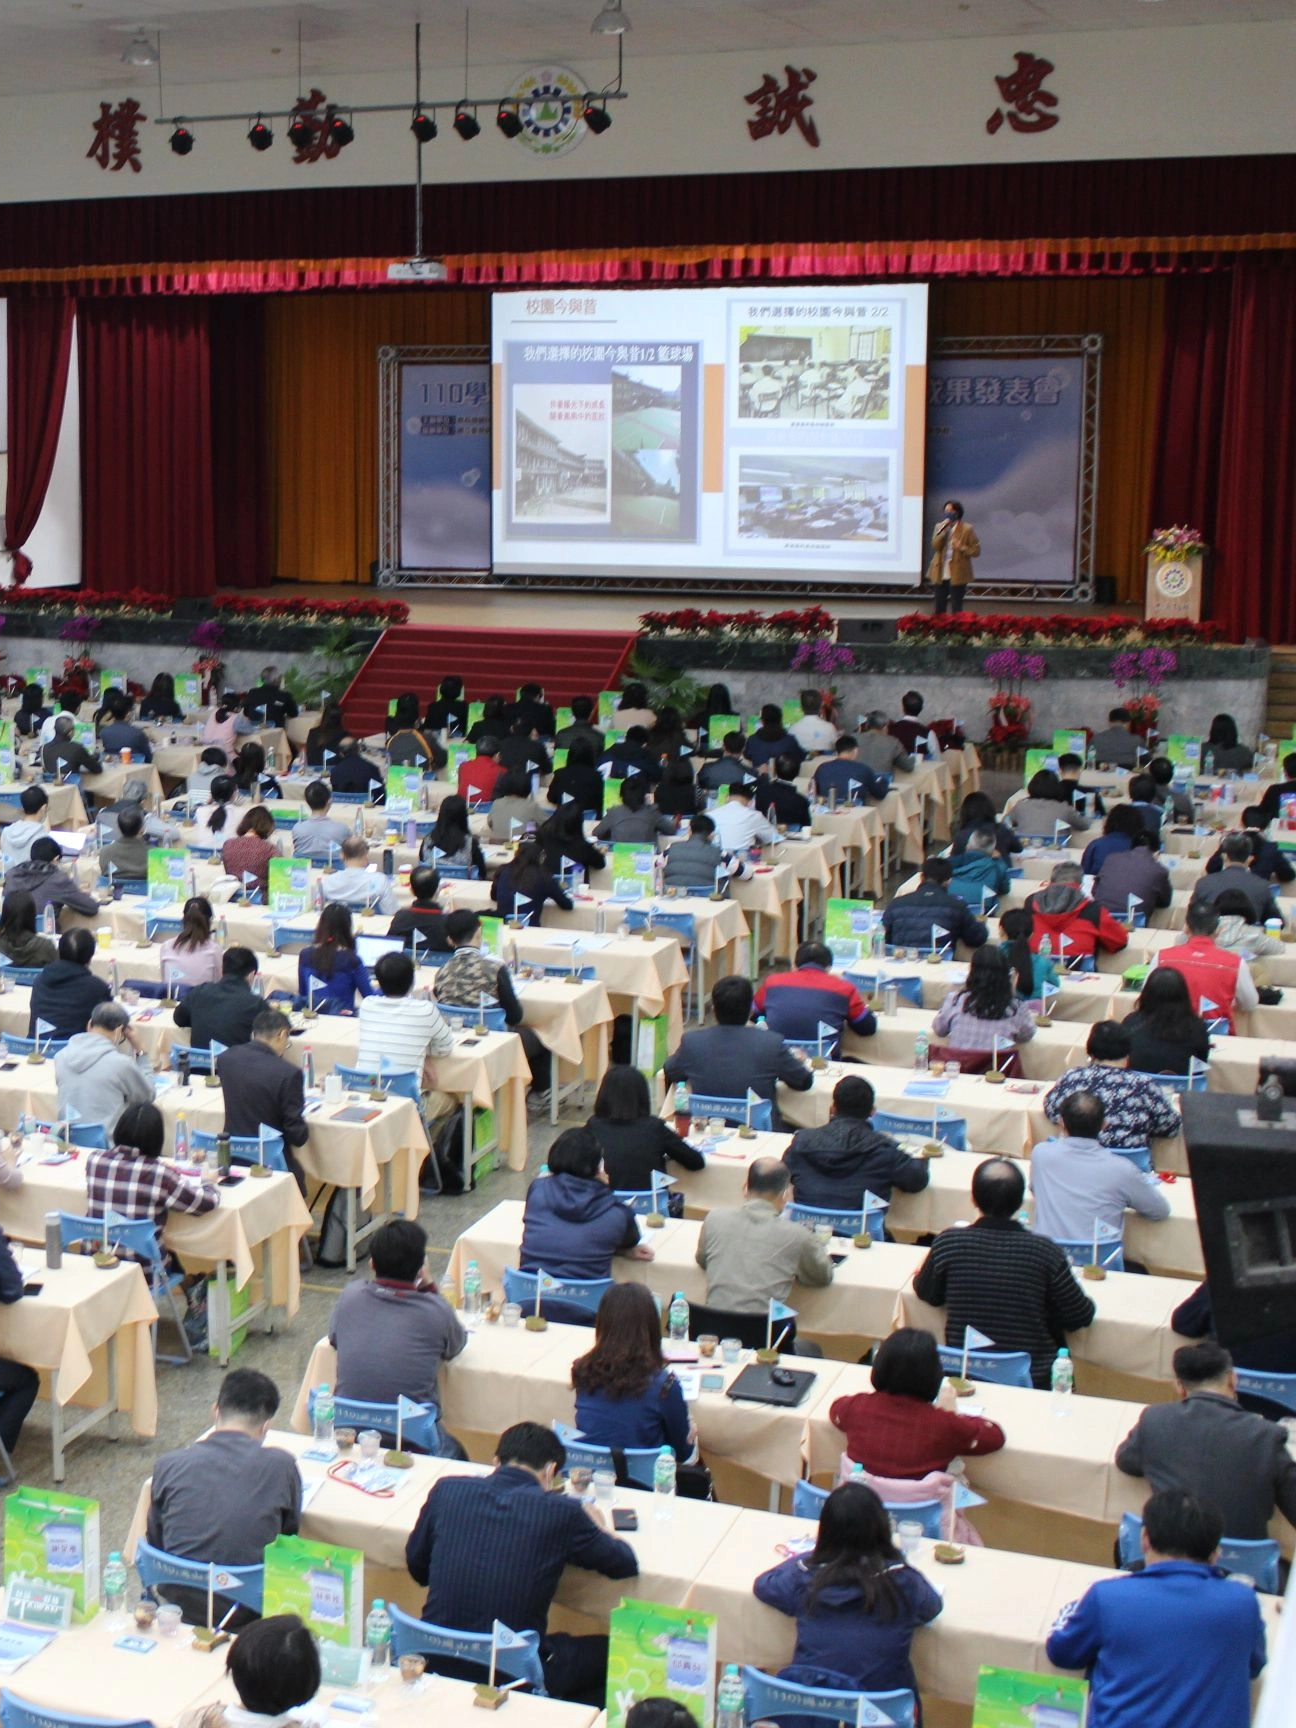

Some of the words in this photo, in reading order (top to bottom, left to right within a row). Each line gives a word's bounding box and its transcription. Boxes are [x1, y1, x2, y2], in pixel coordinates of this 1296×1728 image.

[743, 64, 821, 148] 誠
[986, 52, 1060, 135] 忠
[525, 297, 598, 315] 校園今與昔
[870, 306, 889, 318] 2/2
